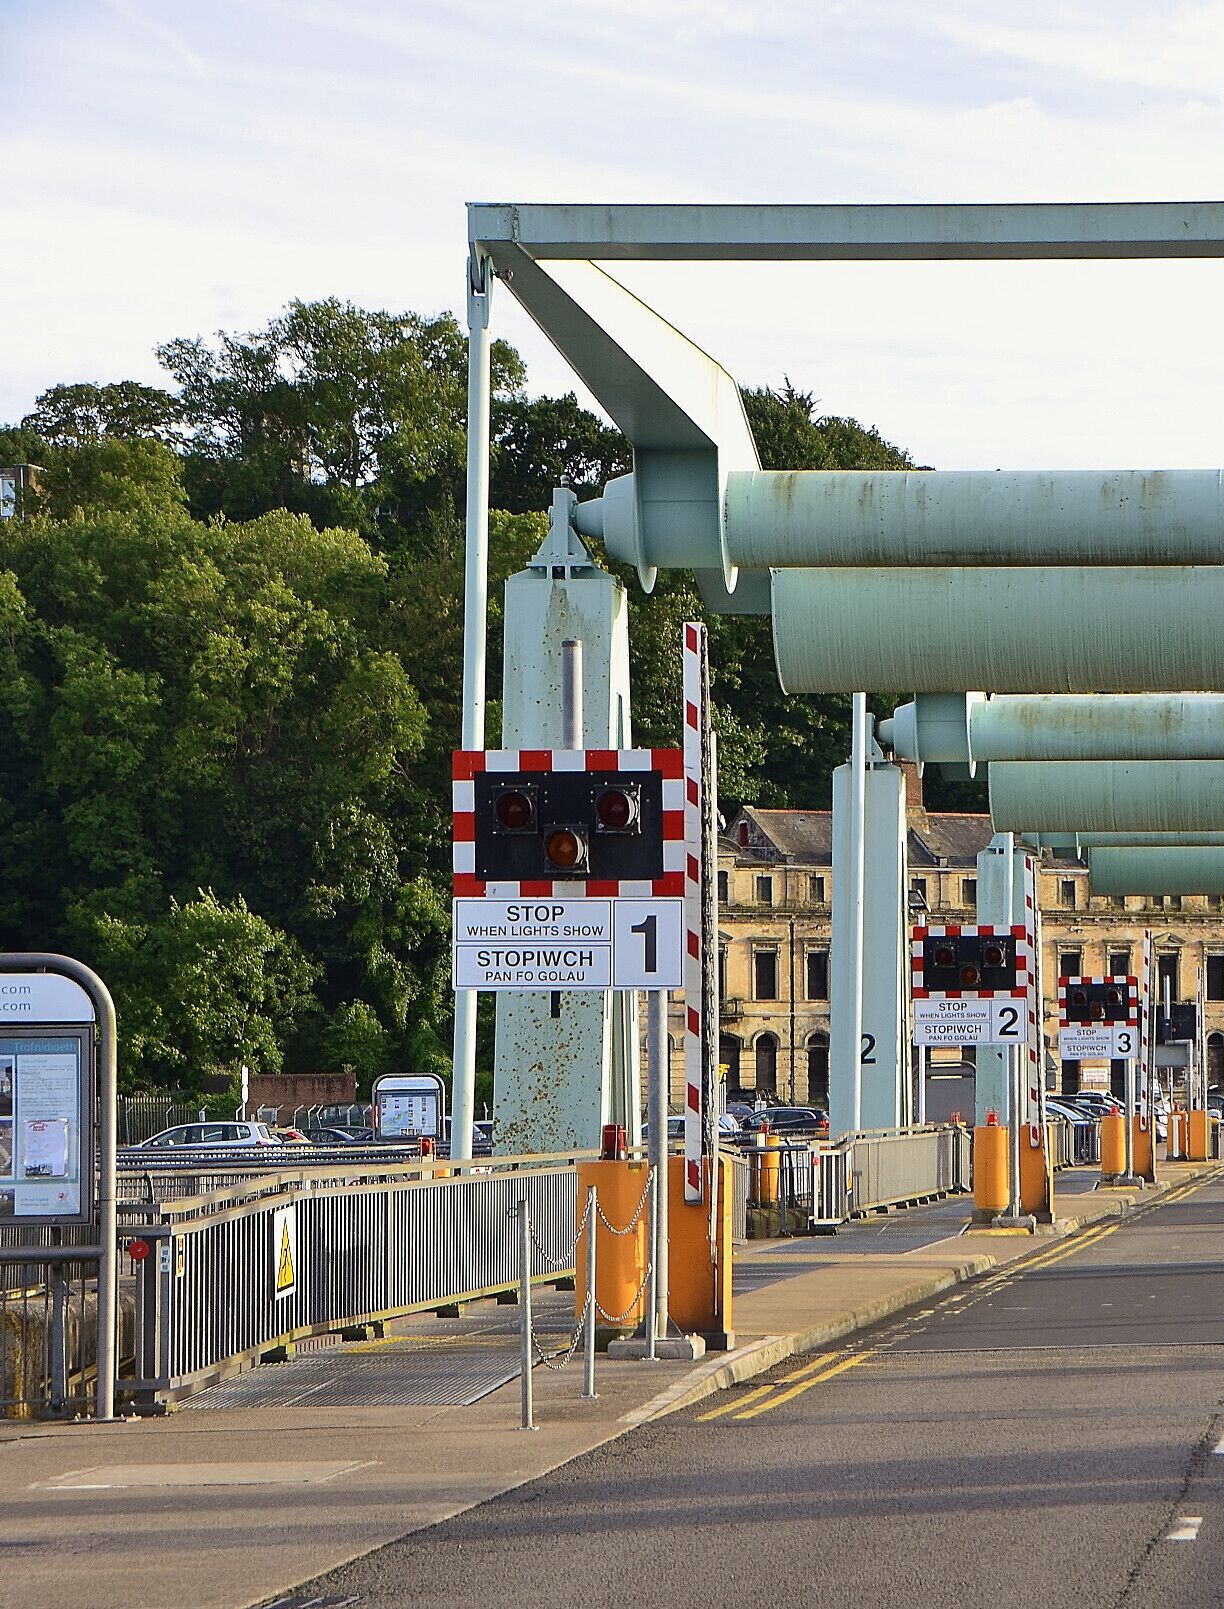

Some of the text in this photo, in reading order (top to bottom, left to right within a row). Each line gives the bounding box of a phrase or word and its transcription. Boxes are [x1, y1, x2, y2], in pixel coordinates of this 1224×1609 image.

[506, 905, 565, 922] STOP
[467, 925, 604, 937] WHEN LIGHTS SHOW
[631, 915, 657, 973] 1
[477, 950, 593, 967] STOPIWCH
[485, 971, 585, 982] PAN FO GOLAU
[939, 1002, 968, 1012] STOP
[925, 1024, 982, 1034] STOPIWCH
[998, 1006, 1019, 1036] 2
[1117, 1032, 1132, 1053] 3
